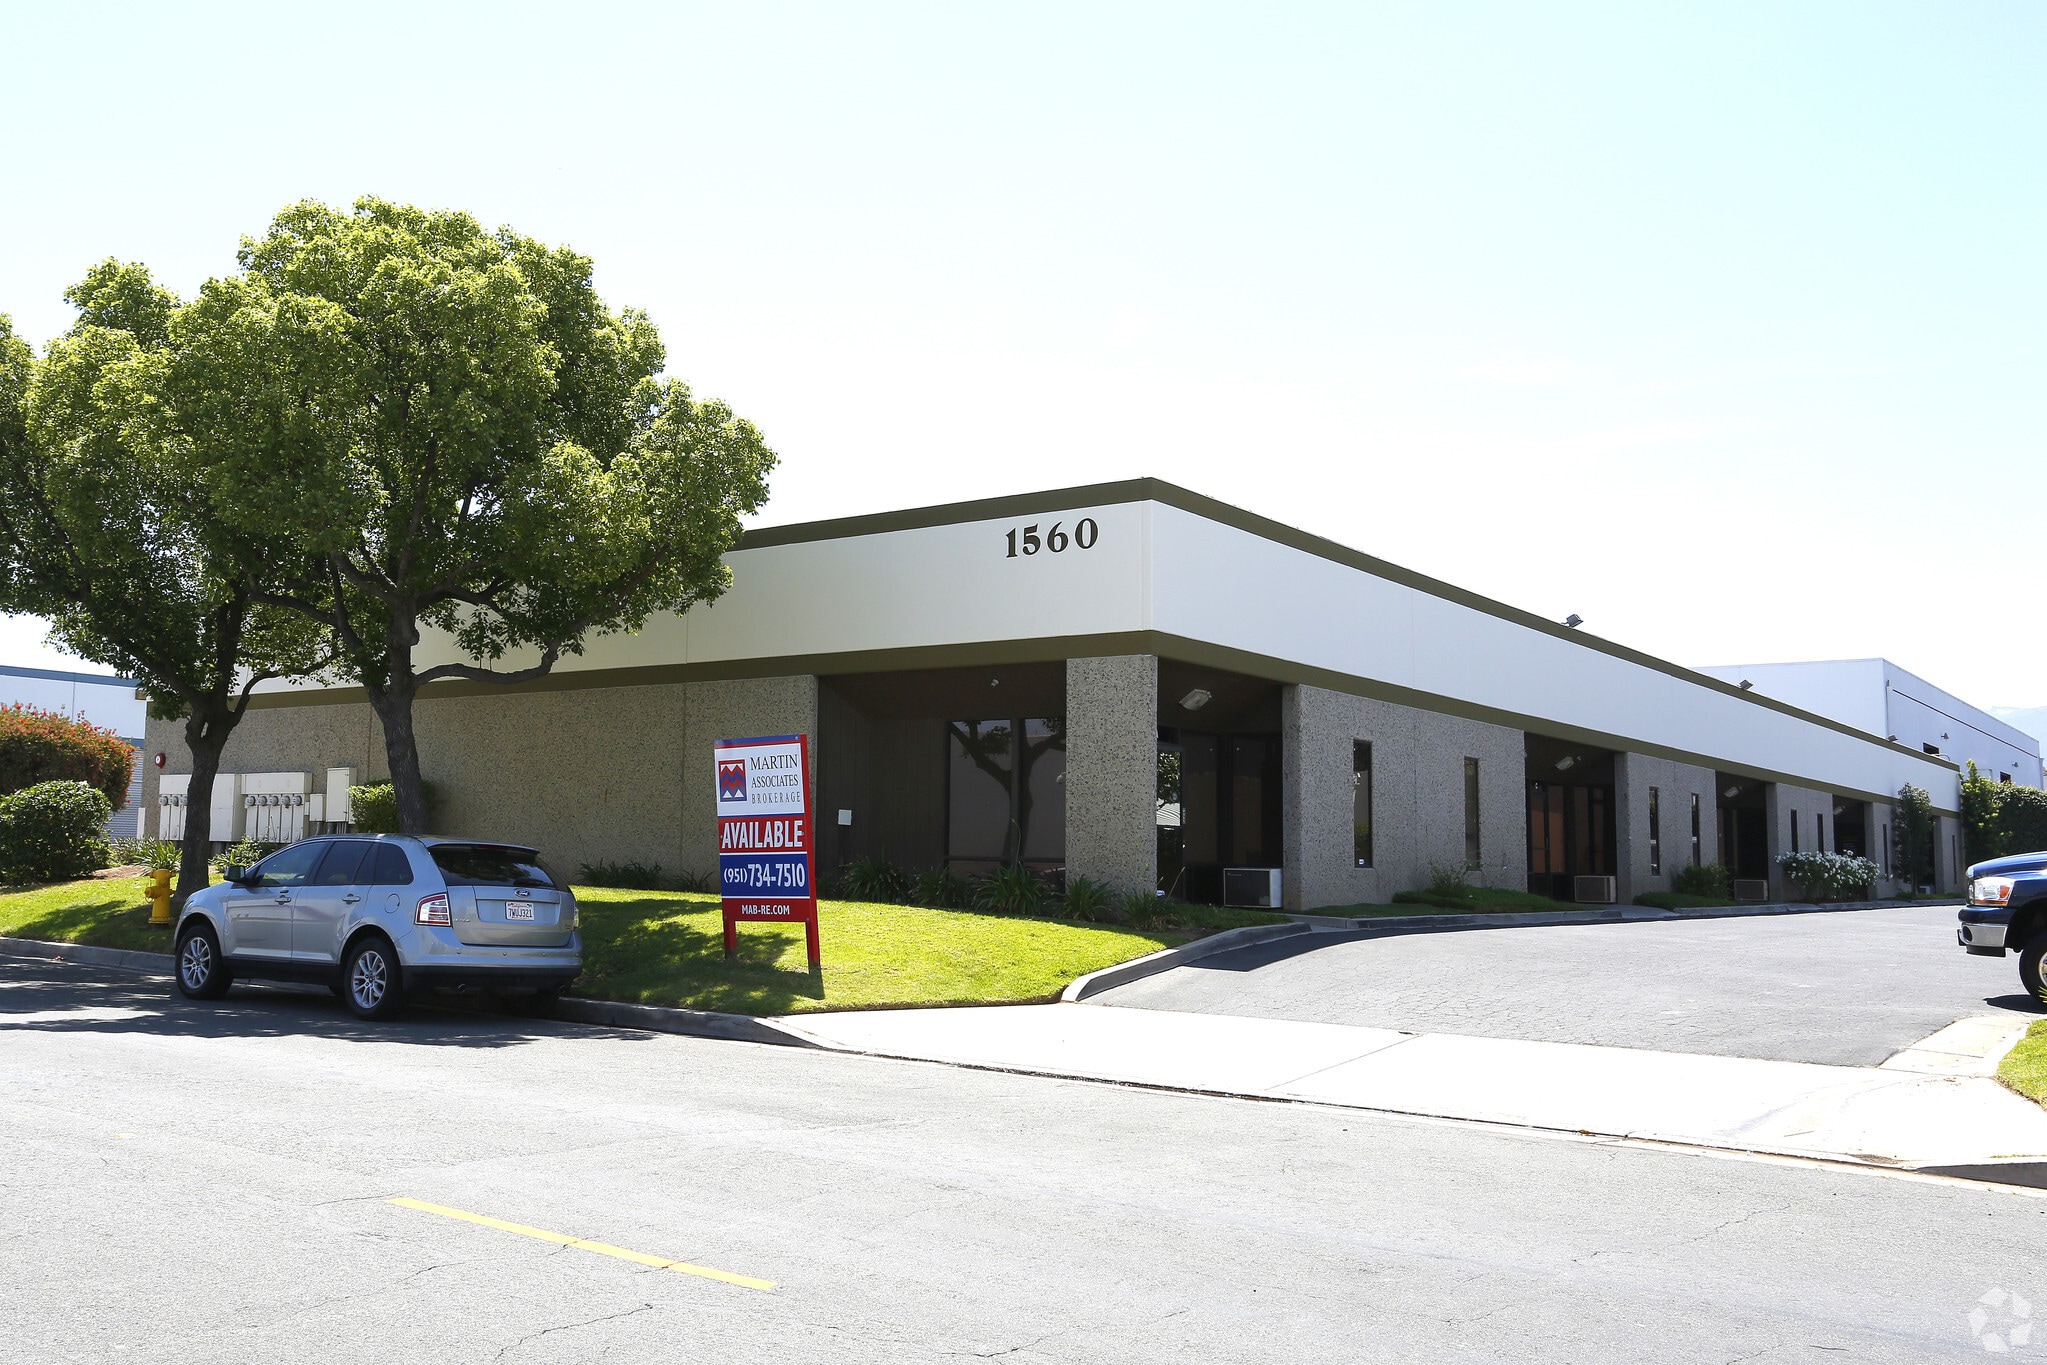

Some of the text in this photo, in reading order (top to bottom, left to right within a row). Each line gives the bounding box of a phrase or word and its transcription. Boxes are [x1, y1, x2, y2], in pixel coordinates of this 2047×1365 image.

[1006, 518, 1099, 558] 1560
[750, 754, 798, 771] MARTIN
[751, 774, 799, 789] ASSOCIATES
[752, 791, 801, 805] BROKERAGE
[721, 820, 803, 849] AVAILABLE
[741, 904, 790, 916] MAB-RE.COM
